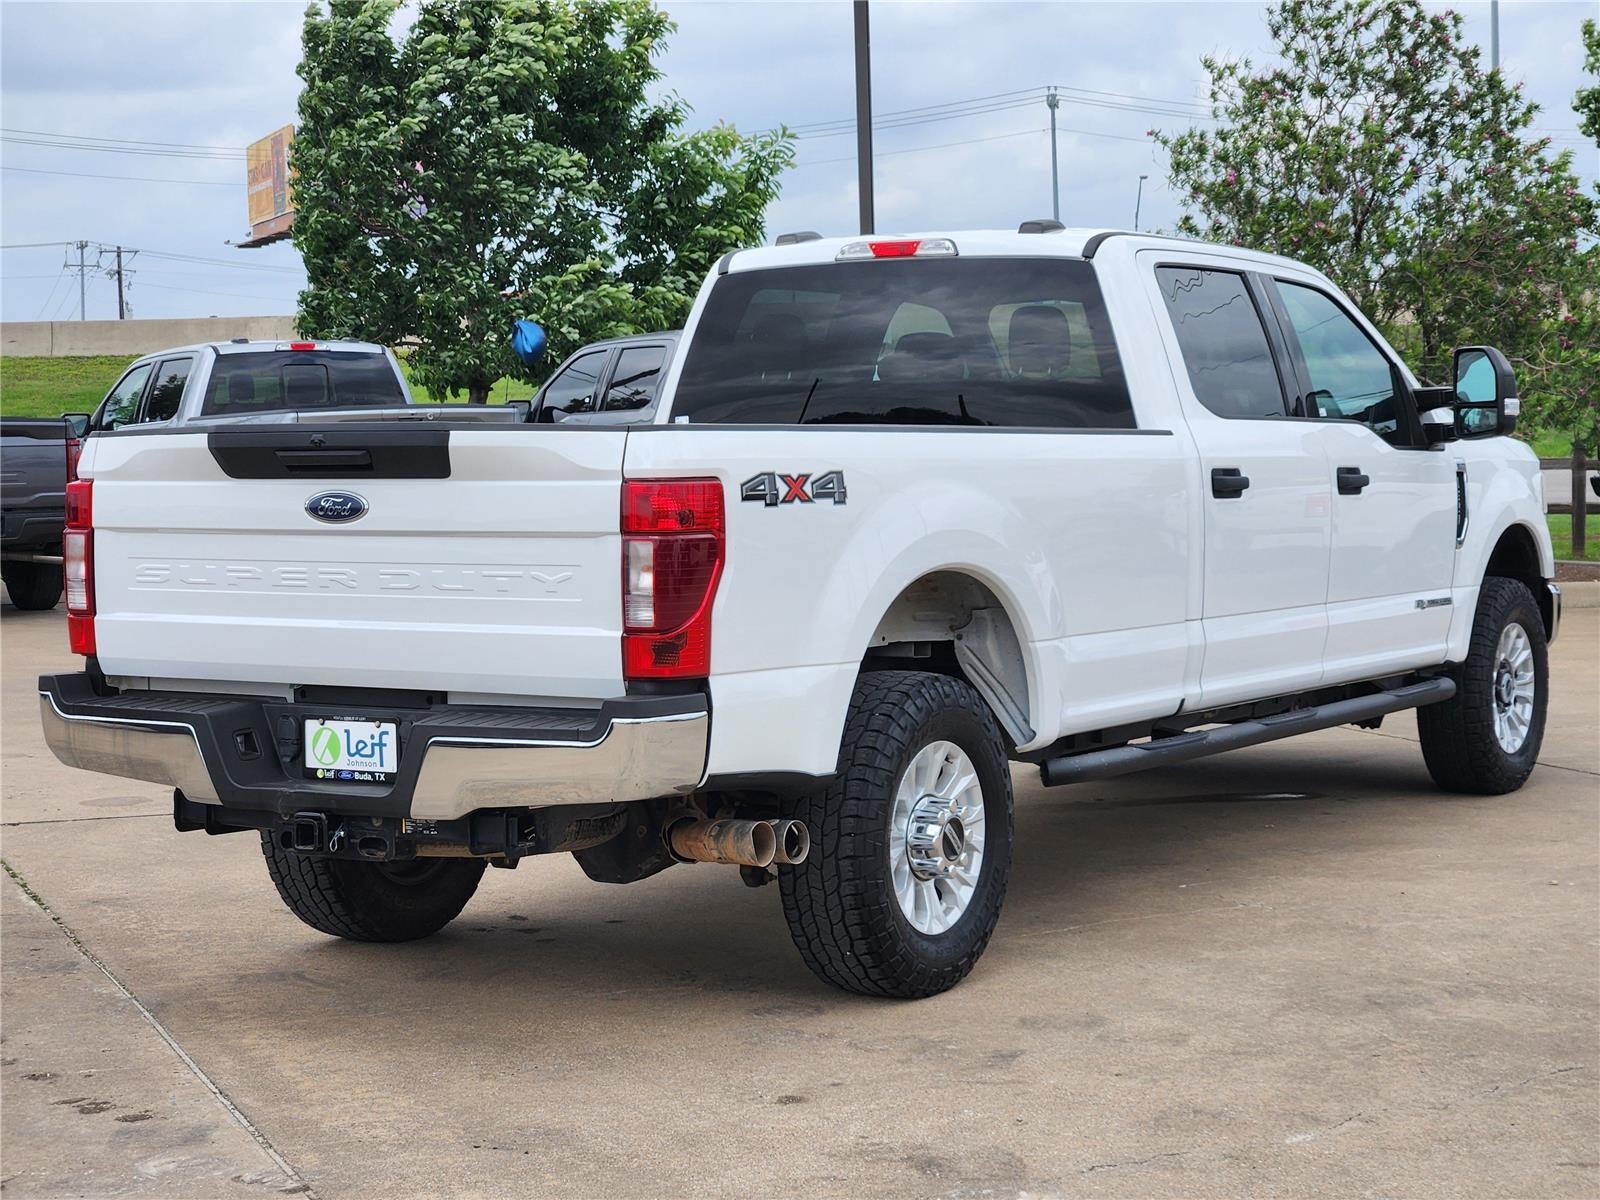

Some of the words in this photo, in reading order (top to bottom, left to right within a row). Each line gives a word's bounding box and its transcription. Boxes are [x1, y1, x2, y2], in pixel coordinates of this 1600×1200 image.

[317, 497, 352, 516] Ford
[135, 562, 358, 590] SUPER
[378, 568, 575, 594] DUTY
[344, 729, 390, 768] leif
[347, 759, 378, 769] Johnson
[354, 771, 374, 781] Buda,
[375, 772, 386, 781] TX
